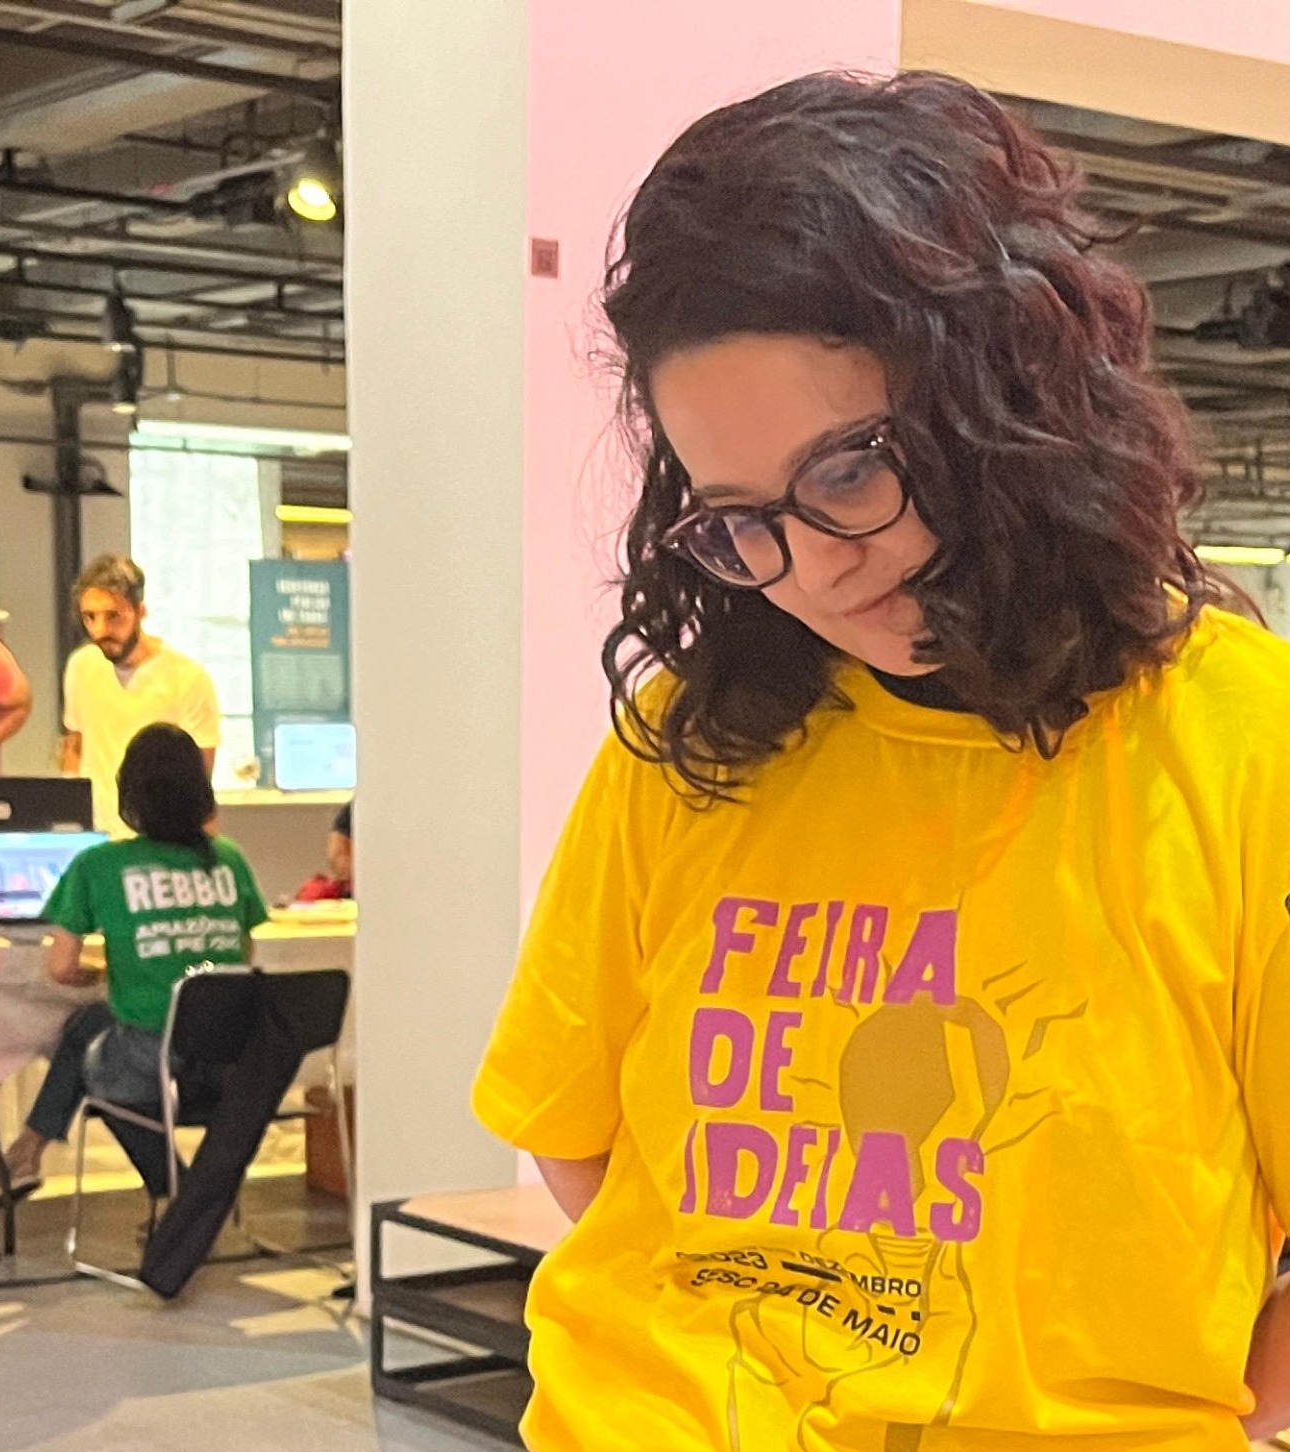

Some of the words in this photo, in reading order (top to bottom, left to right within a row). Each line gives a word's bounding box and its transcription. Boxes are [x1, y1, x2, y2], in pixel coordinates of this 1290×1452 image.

[699, 895, 957, 1005] FEIRA
[689, 1007, 803, 1112] DE
[678, 1118, 985, 1243] IDEIAS
[796, 1288, 840, 1318] DE
[842, 1308, 921, 1357] MAIO
